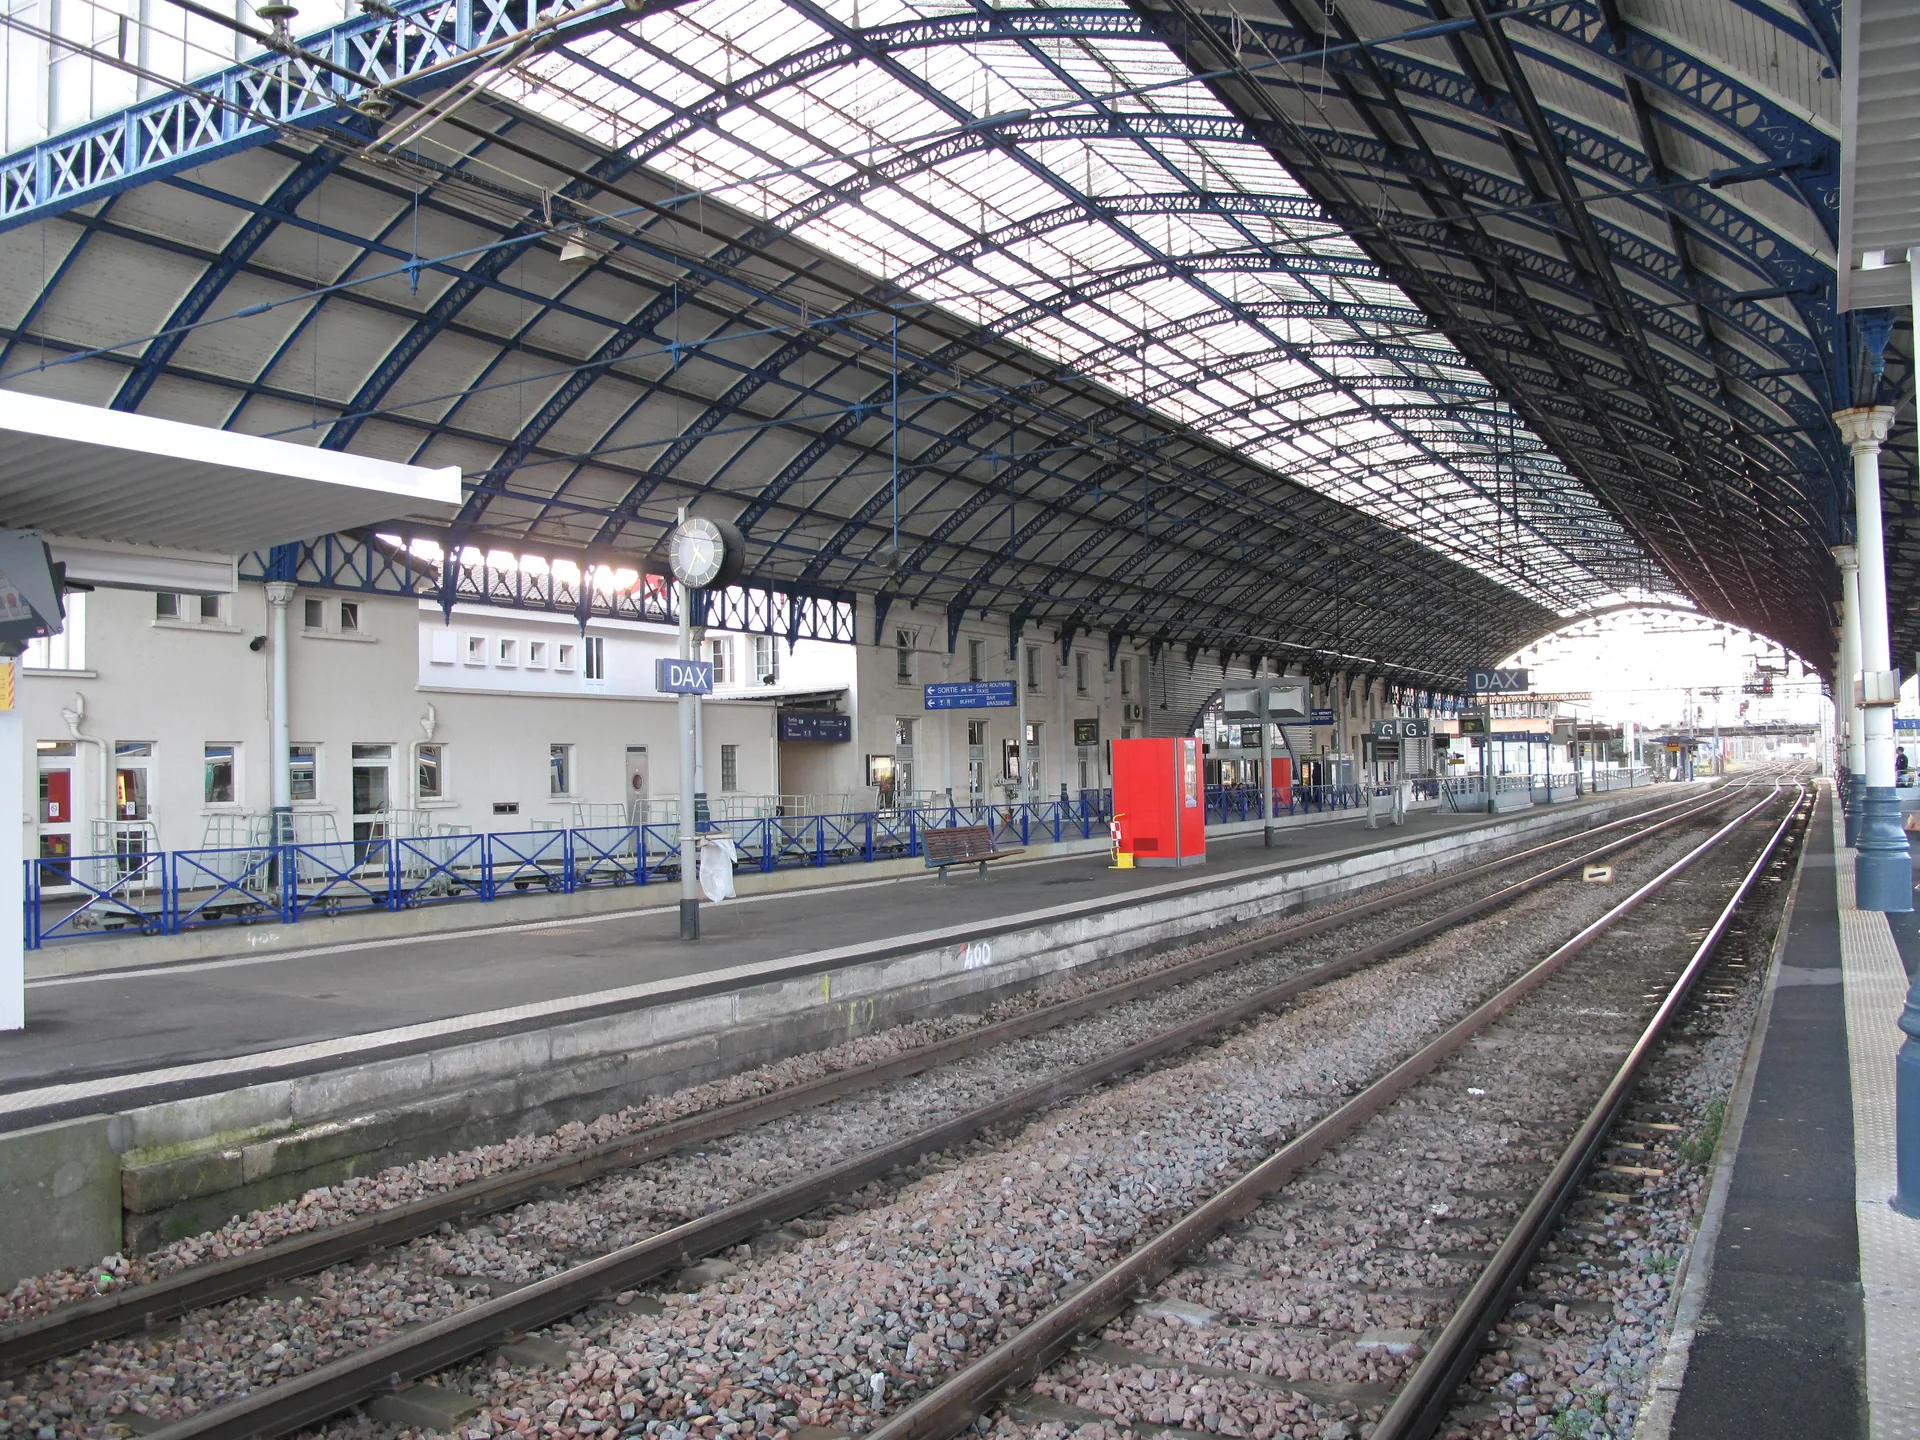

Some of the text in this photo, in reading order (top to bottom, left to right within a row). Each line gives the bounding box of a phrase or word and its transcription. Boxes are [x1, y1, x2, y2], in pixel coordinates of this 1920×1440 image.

[671, 664, 708, 689] DAX
[1475, 672, 1519, 690] DAX
[937, 686, 958, 694] SORTIE
[1382, 723, 1393, 734] G
[1405, 723, 1417, 736] G
